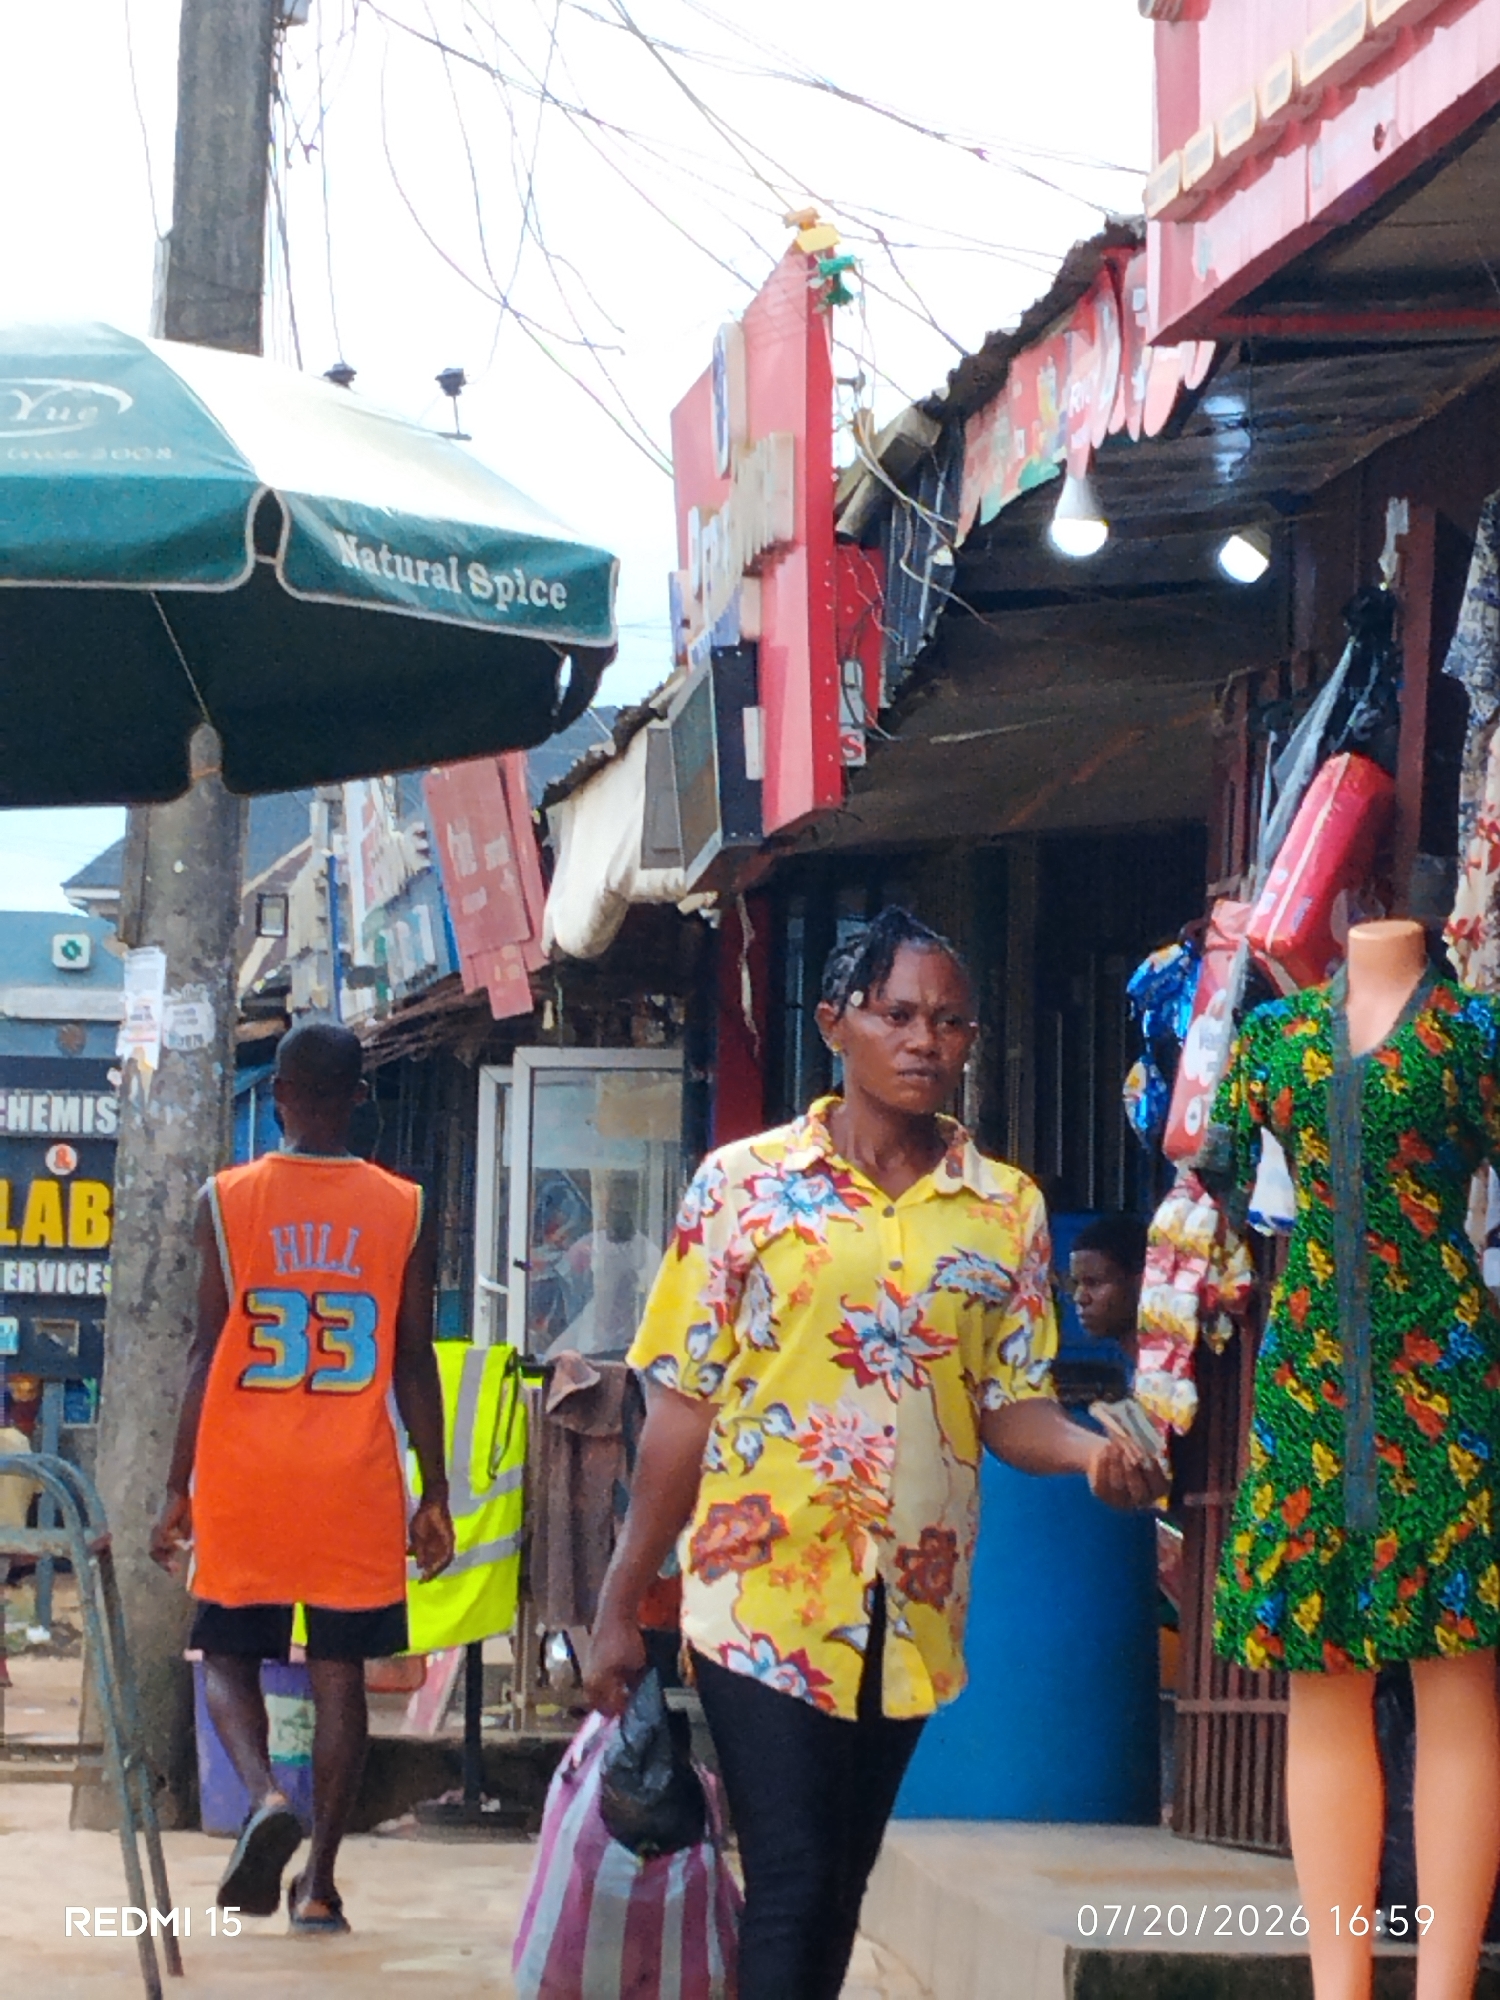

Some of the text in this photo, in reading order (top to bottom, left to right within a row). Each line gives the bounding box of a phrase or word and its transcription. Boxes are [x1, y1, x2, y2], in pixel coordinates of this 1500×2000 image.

[333, 529, 568, 612] Natural Spice
[269, 1222, 363, 1279] HILL
[237, 1287, 378, 1396] 33
